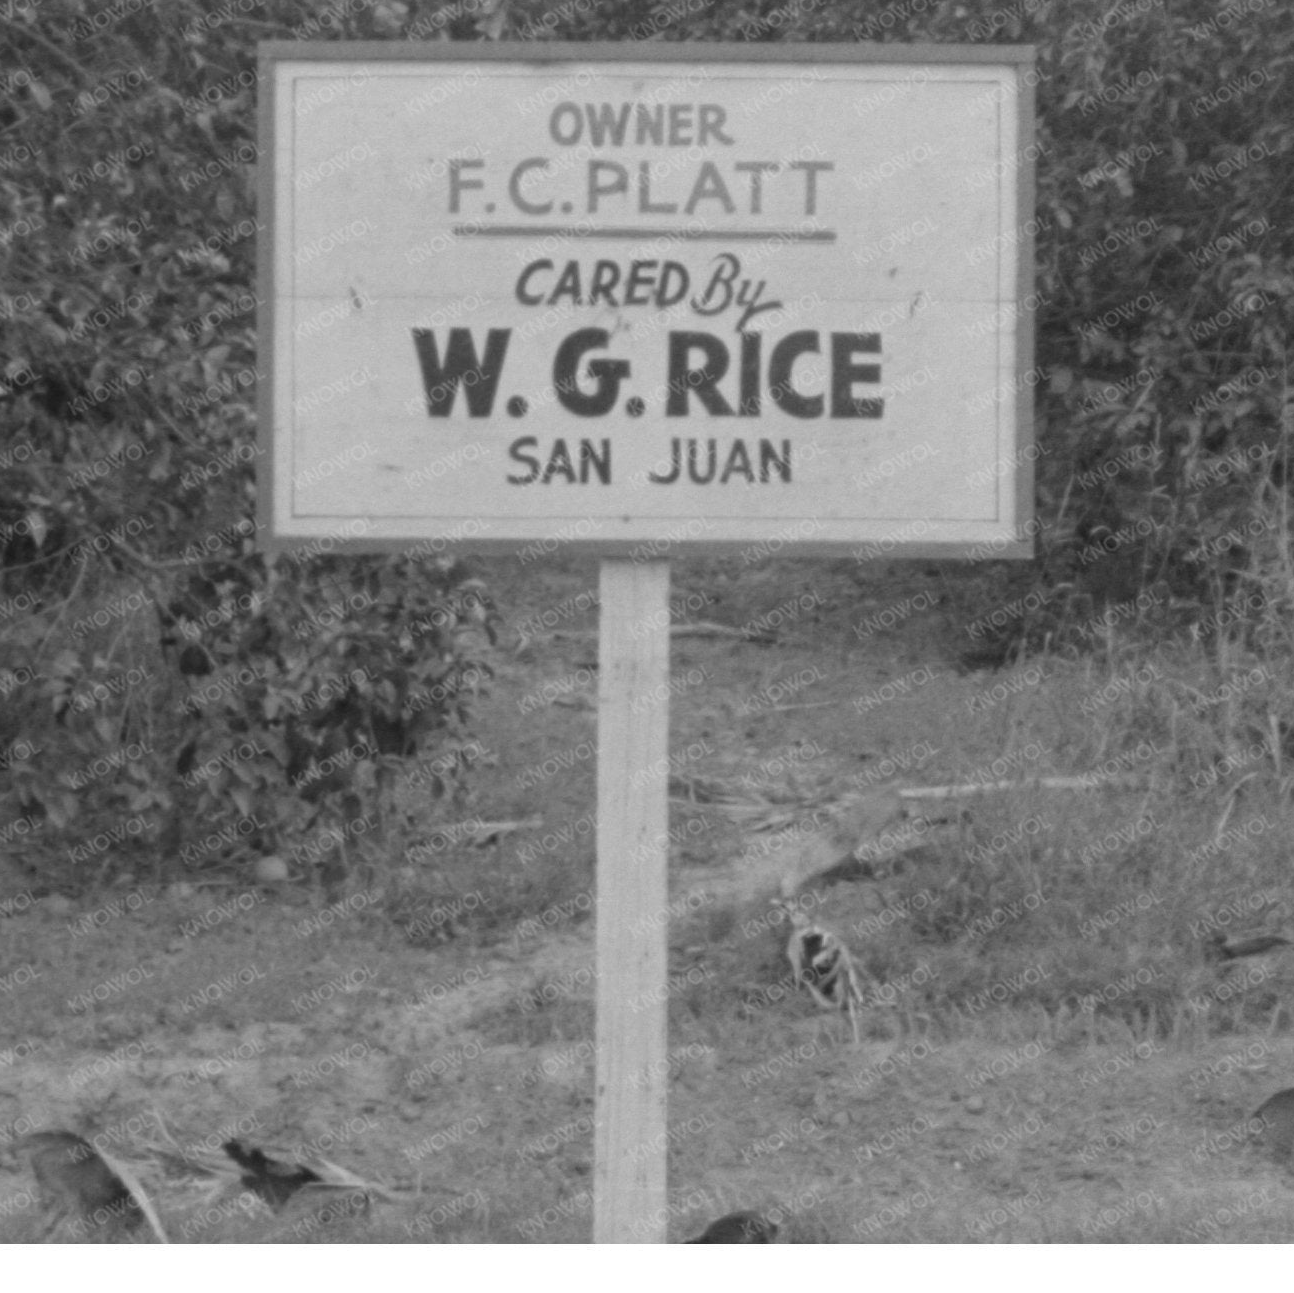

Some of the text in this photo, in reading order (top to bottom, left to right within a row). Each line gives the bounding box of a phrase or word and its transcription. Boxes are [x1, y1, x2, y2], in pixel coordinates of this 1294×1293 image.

[548, 101, 735, 148] OWNER
[514, 252, 783, 332] CARED By
[666, 329, 885, 420] RICE
[506, 436, 793, 486] SAN JUAN
